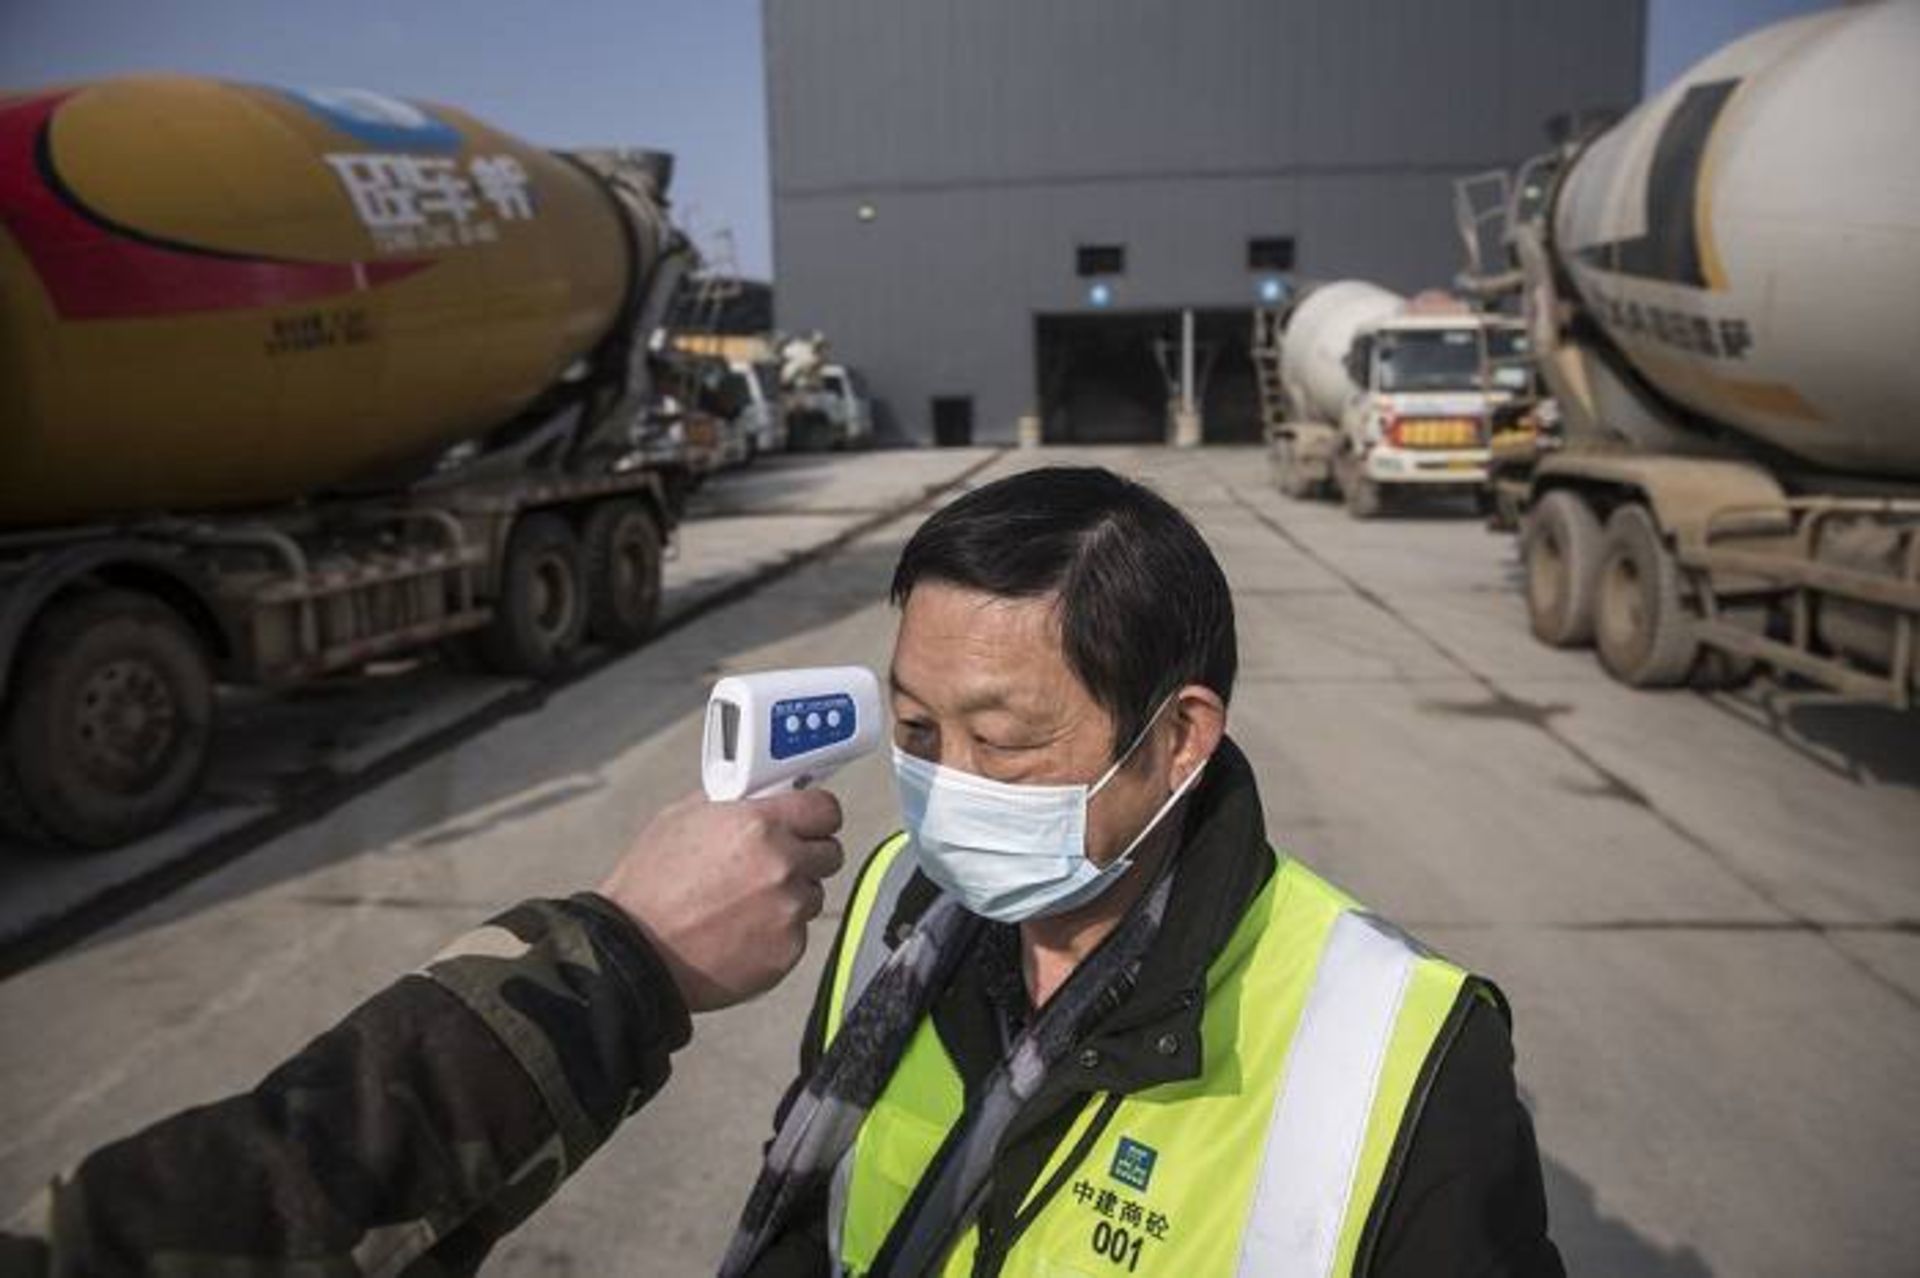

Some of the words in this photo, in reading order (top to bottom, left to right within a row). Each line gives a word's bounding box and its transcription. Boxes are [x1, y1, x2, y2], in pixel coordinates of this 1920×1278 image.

[1072, 1180, 1169, 1241] 中建商砼
[1092, 1220, 1144, 1273] 001
